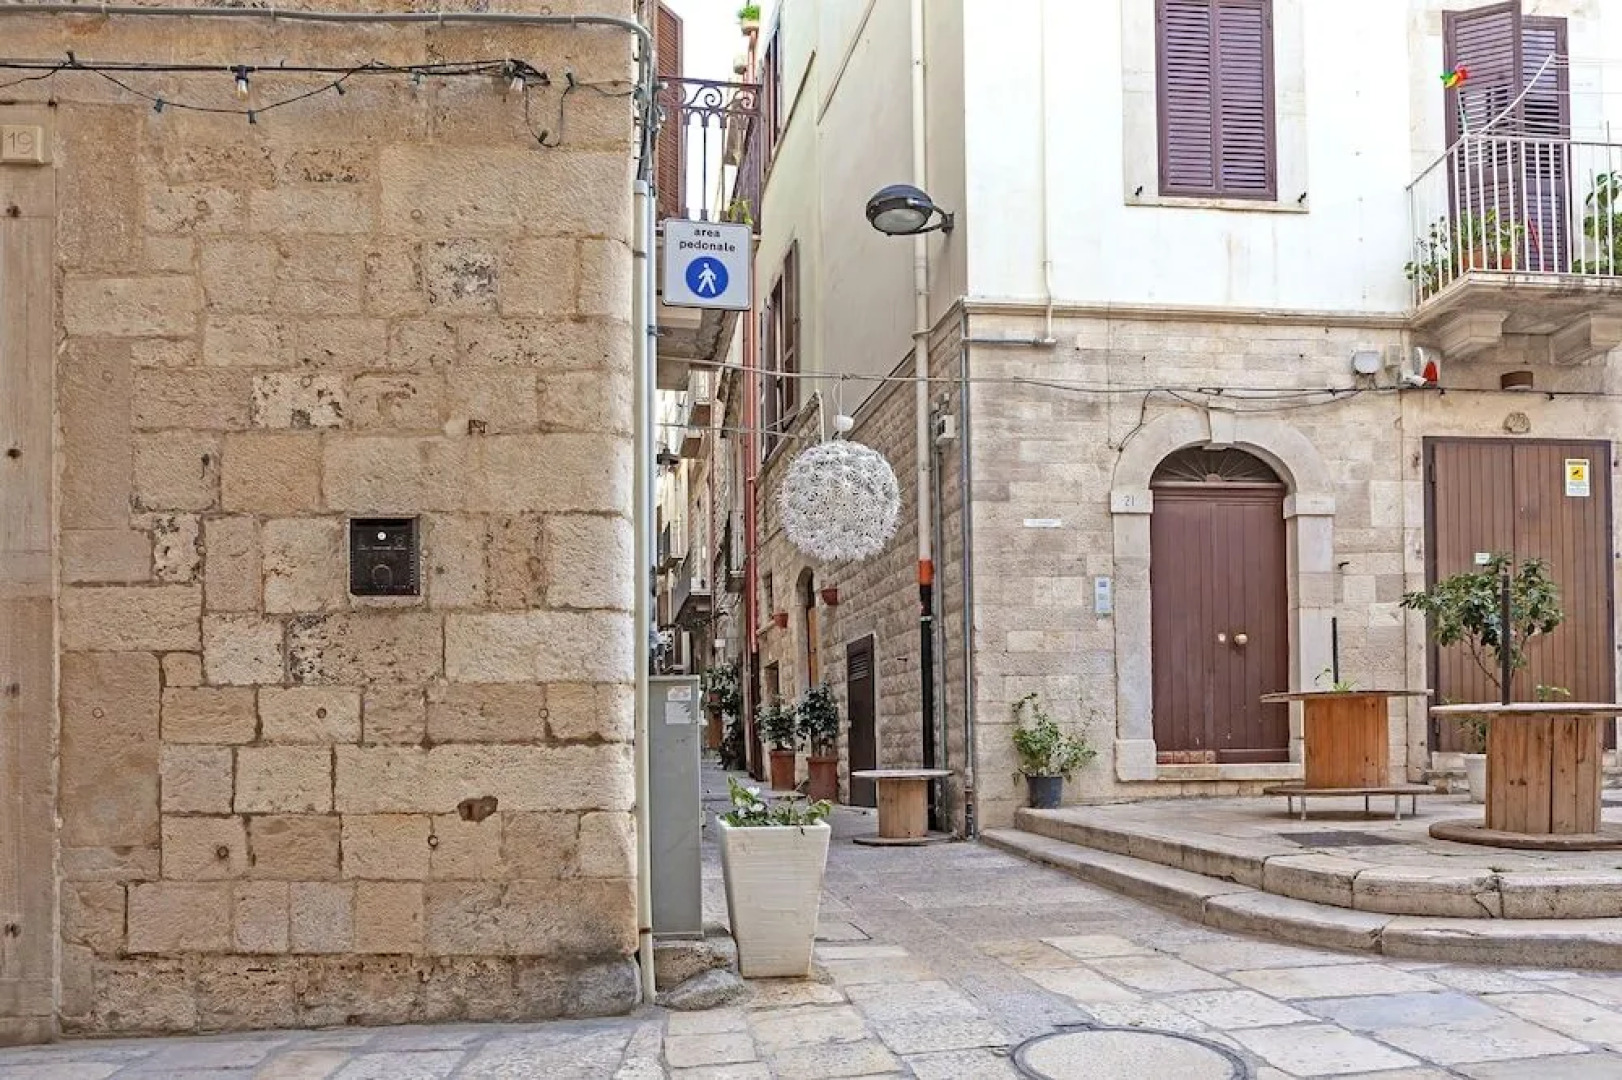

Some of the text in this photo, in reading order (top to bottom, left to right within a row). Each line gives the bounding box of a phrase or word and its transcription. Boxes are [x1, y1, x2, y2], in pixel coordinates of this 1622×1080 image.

[6, 130, 33, 155] 19
[693, 229, 721, 238] area
[679, 240, 736, 252] pedonale
[1123, 495, 1135, 507] 21
